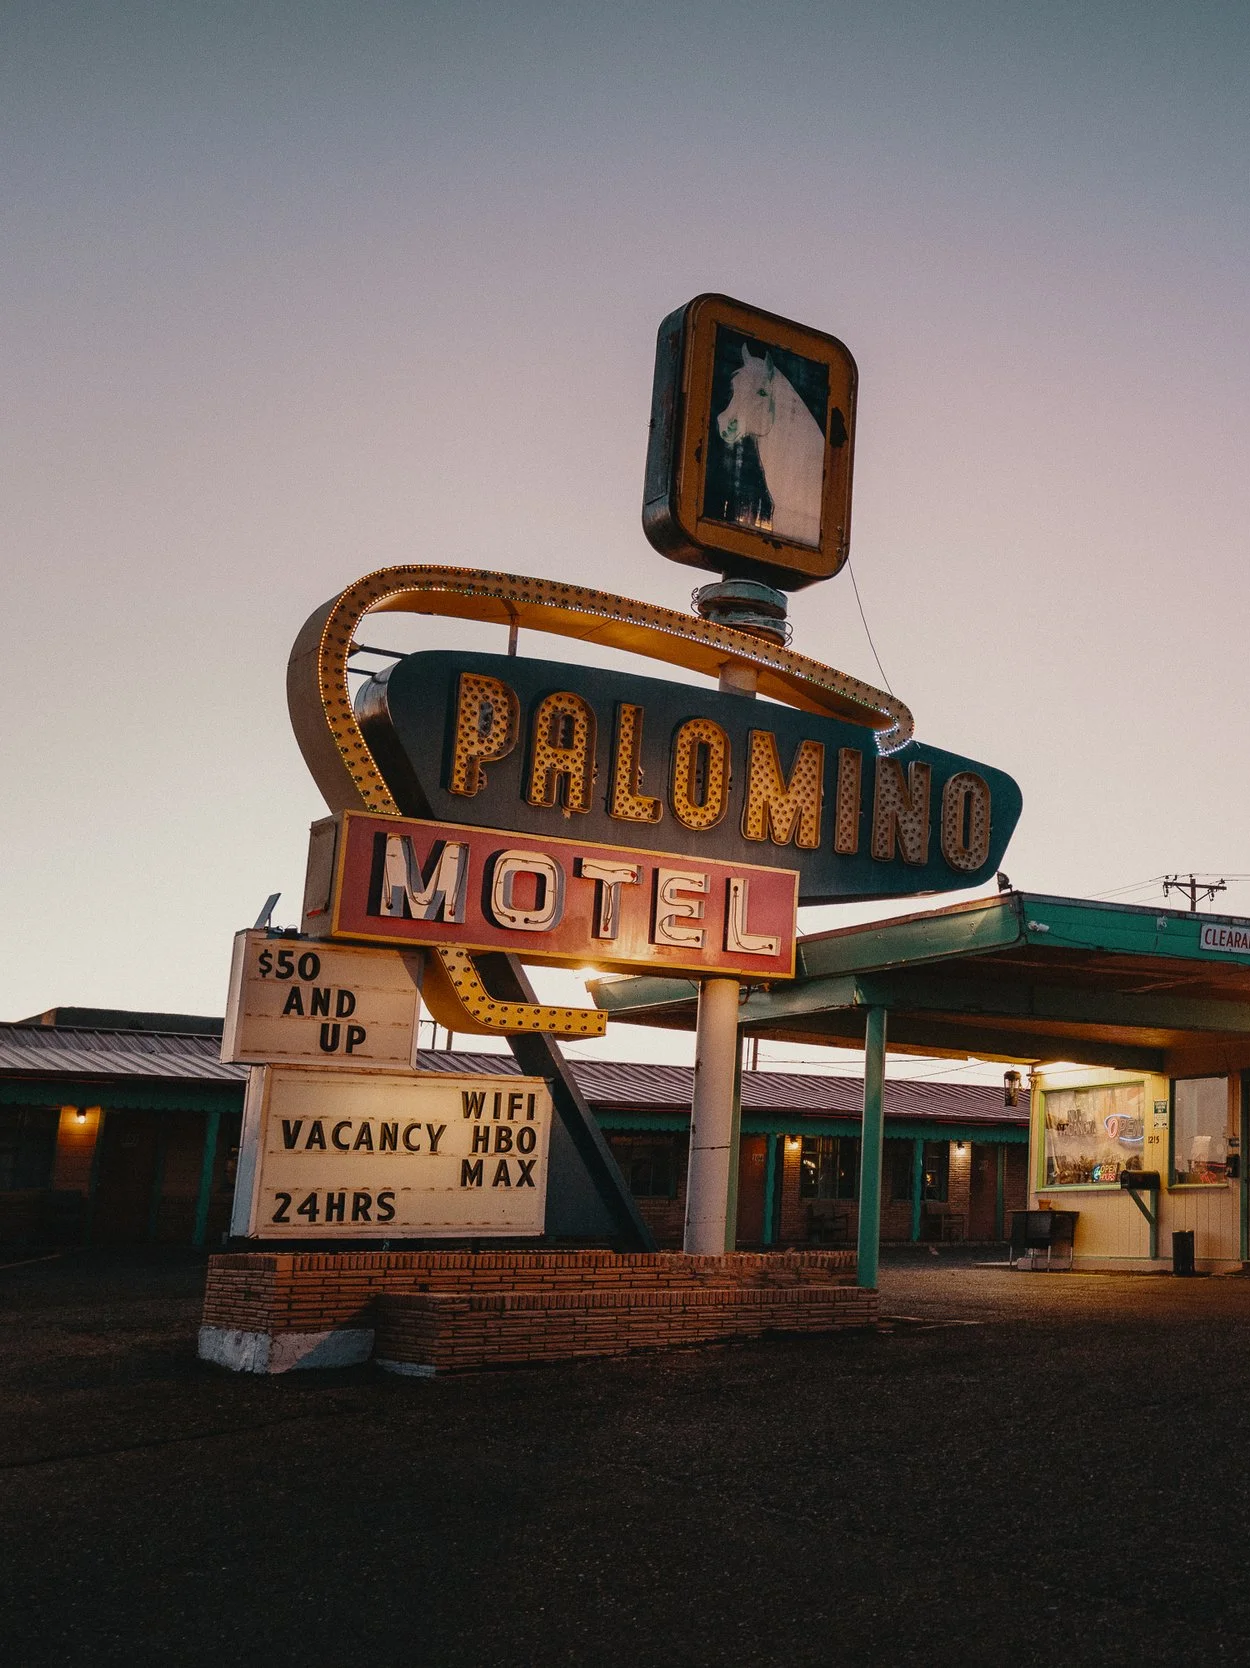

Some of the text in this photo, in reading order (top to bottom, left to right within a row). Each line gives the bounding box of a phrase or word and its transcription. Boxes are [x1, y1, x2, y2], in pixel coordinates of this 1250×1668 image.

[447, 672, 992, 872] PALOMINO
[376, 833, 781, 957] MOTEL
[258, 949, 321, 981] $50
[283, 986, 356, 1018] AND
[319, 1023, 367, 1054] UP
[461, 1091, 536, 1121] WIFI
[281, 1119, 447, 1153] VACANCY
[471, 1126, 537, 1155] HBO
[460, 1158, 537, 1188] MAX
[271, 1191, 396, 1223] 24HRS
